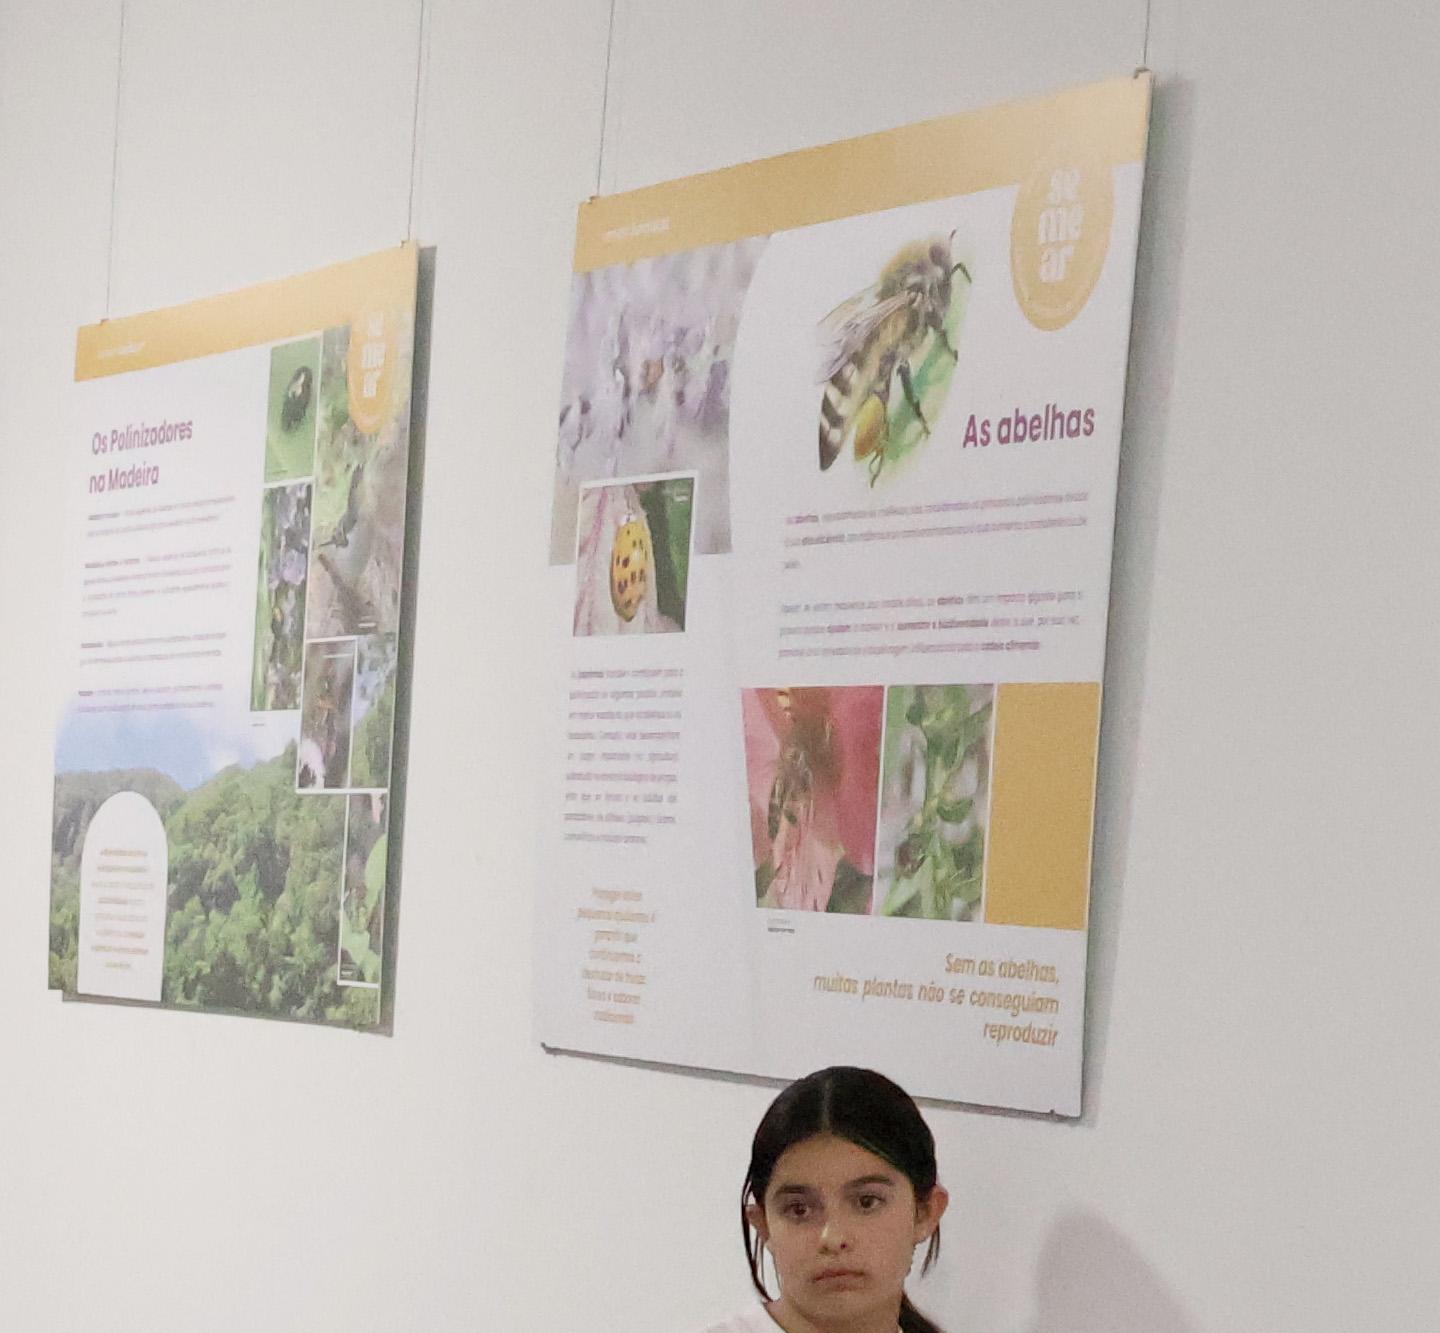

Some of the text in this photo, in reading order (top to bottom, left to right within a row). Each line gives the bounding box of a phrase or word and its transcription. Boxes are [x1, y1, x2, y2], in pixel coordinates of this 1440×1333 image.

[92, 419, 193, 455] Os Polinizadores
[963, 402, 1095, 448] As abelhas
[89, 461, 160, 494] na Madeira
[945, 953, 1060, 984] Sem as abelhas,
[814, 972, 1060, 1018] muitas plantas não se conseguiam
[982, 1022, 1059, 1048] reproduzir
